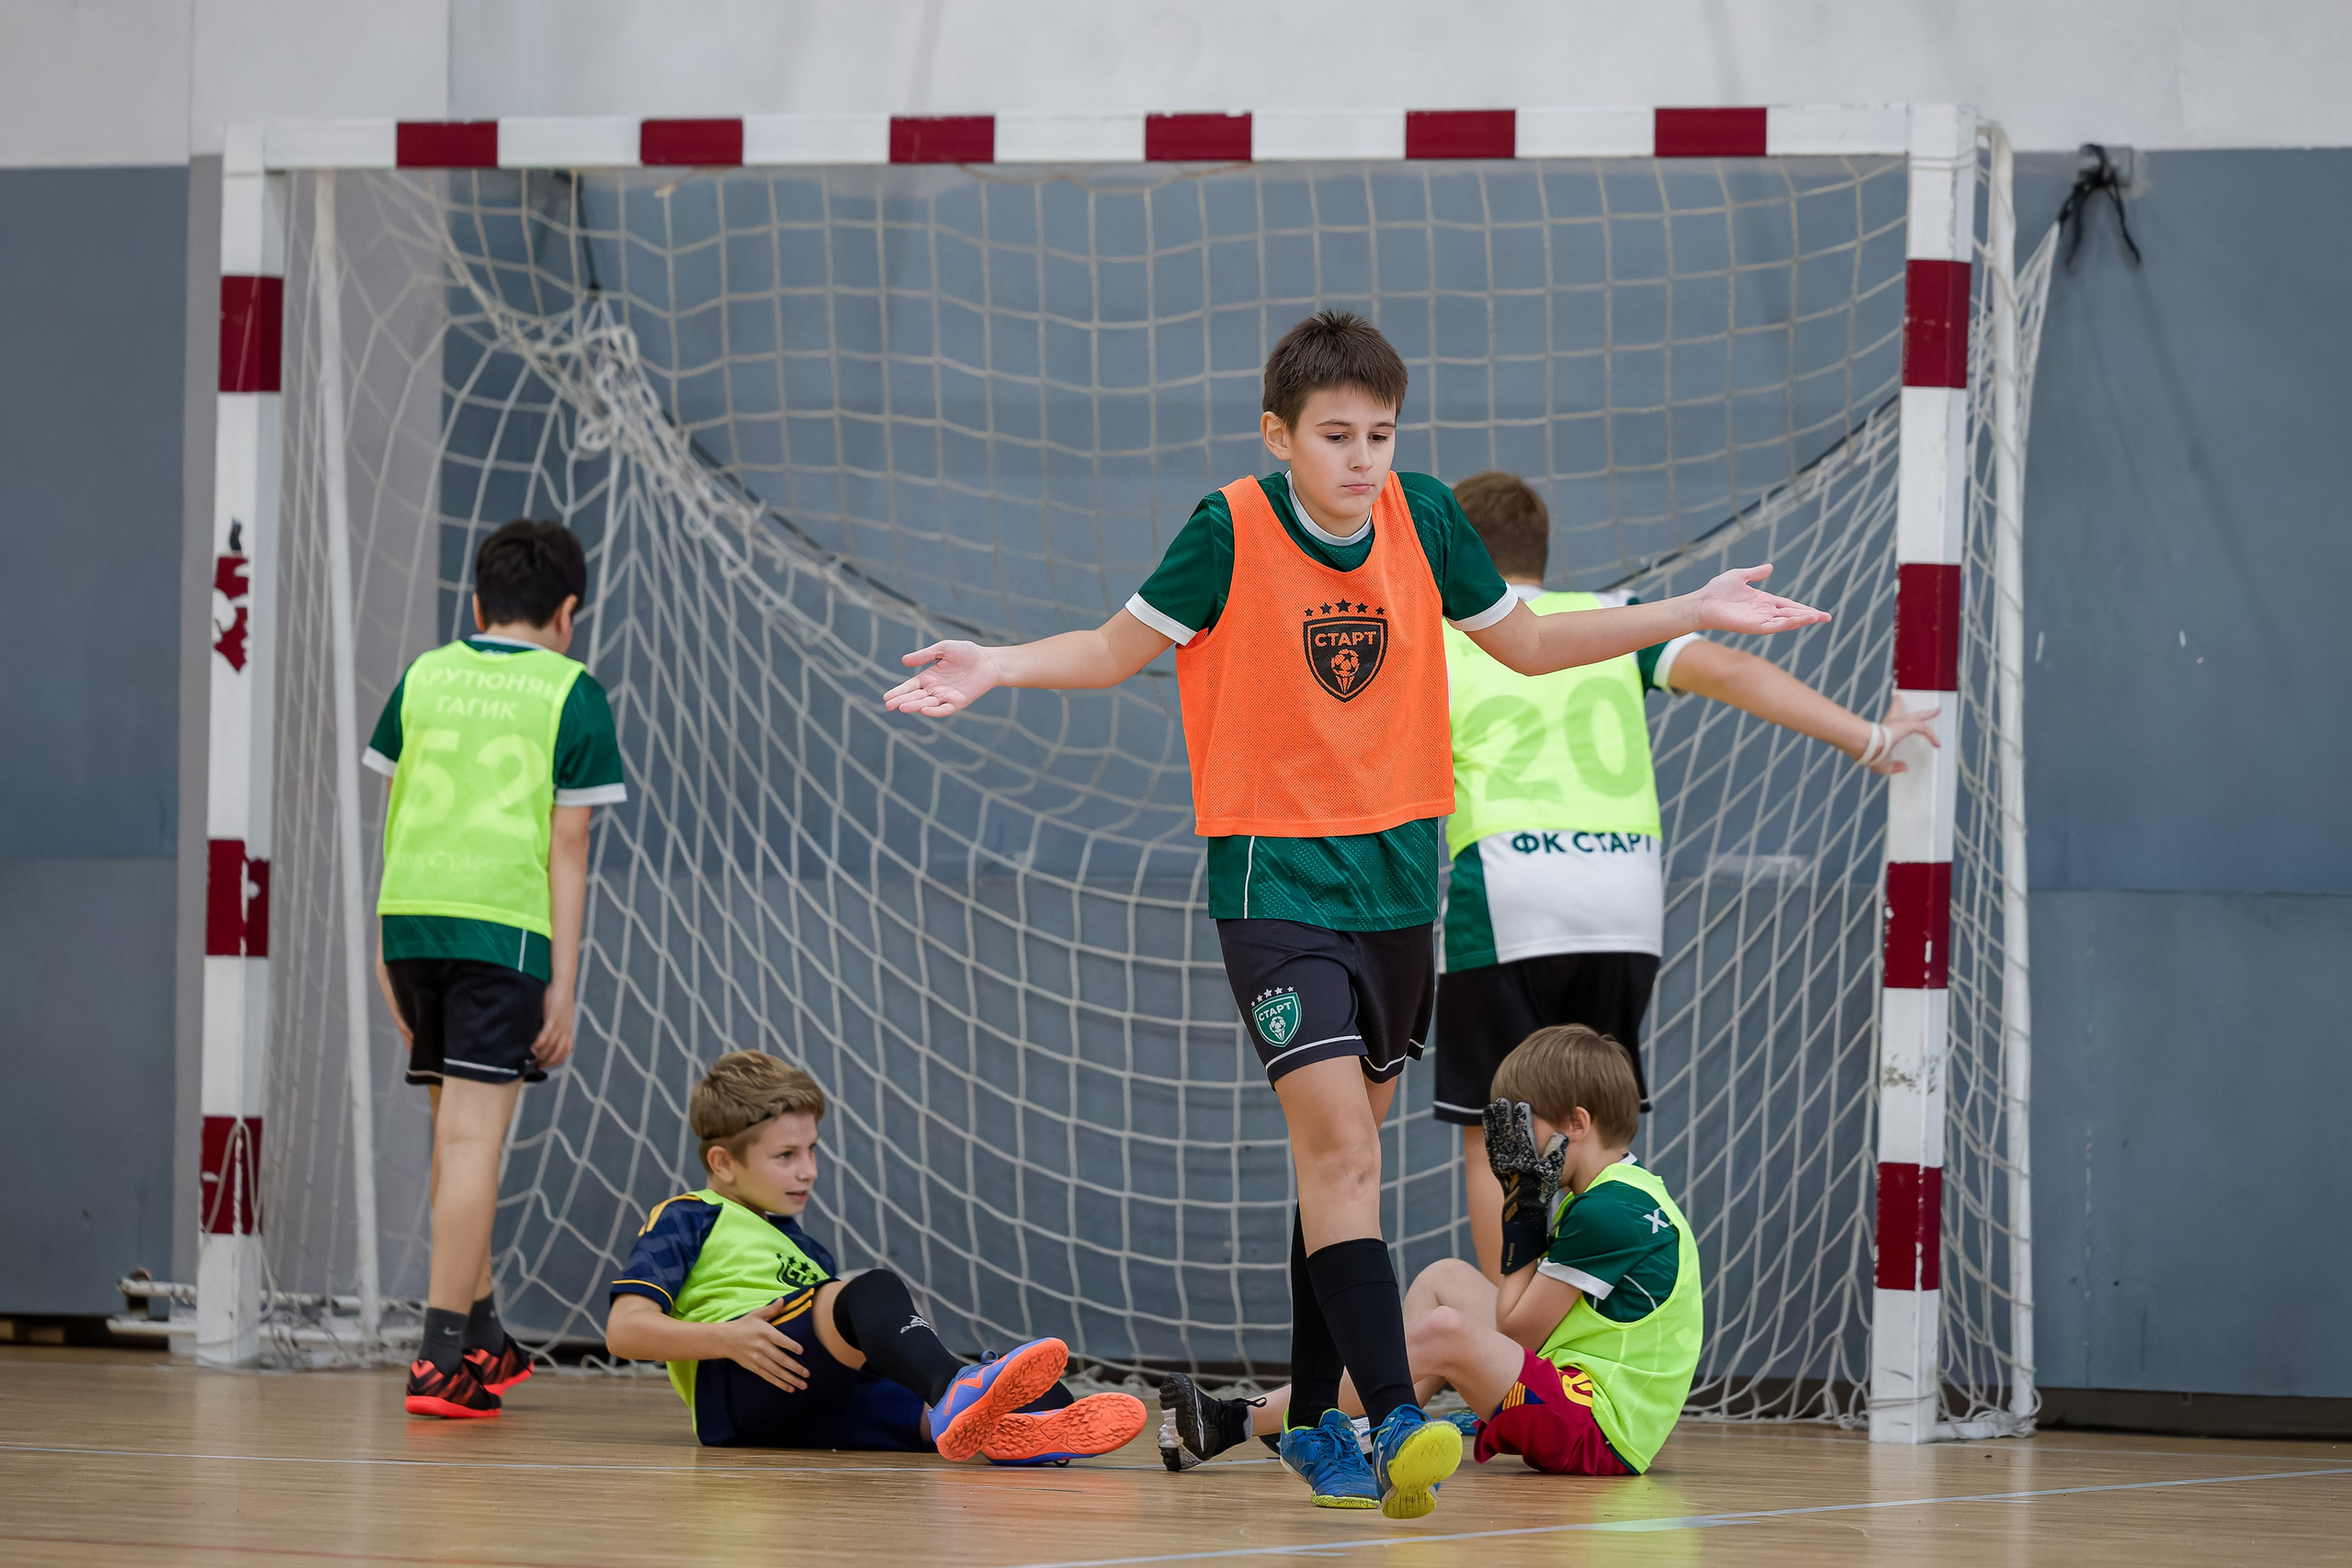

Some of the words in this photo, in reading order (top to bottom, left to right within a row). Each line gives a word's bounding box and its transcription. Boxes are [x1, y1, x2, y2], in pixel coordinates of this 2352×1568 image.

[1315, 631, 1377, 647] СТАРТ
[436, 694, 519, 720] ГАГИК
[1462, 676, 1646, 804] 20
[401, 728, 548, 840] 52
[1511, 831, 1566, 854] ФК
[1259, 1001, 1292, 1021] СТАРТ
